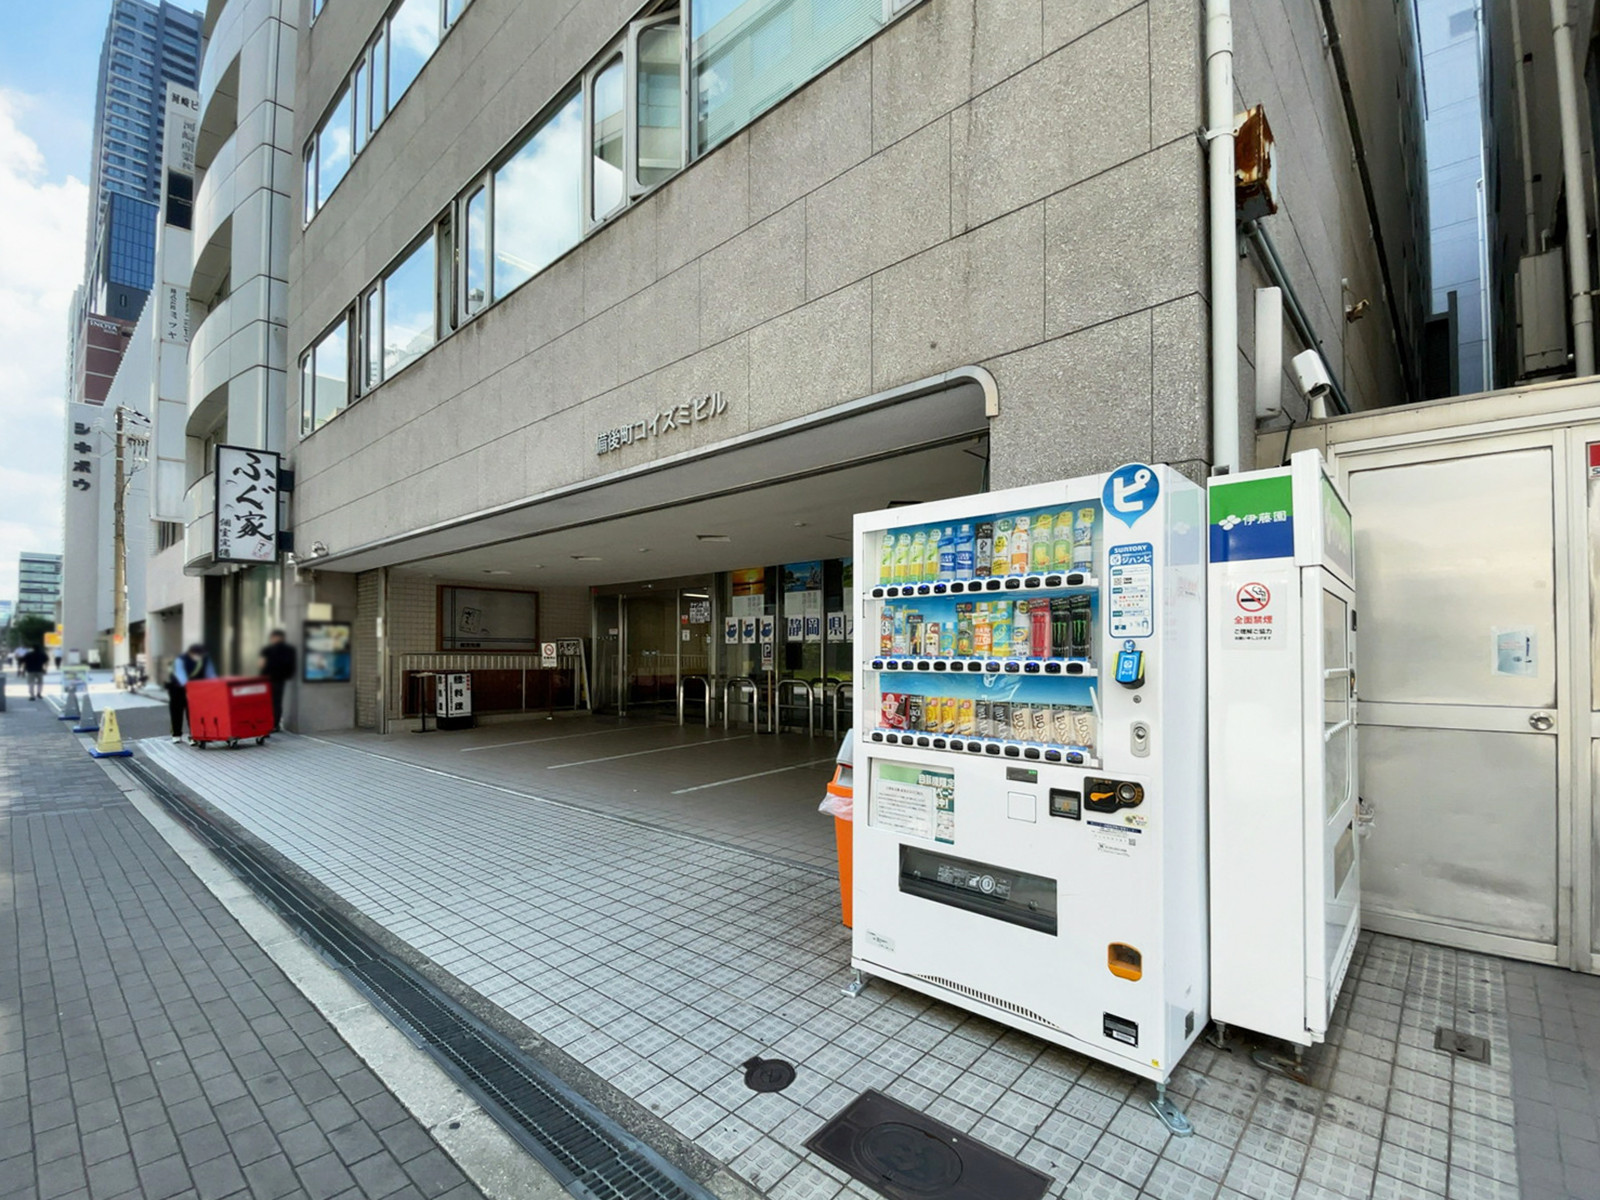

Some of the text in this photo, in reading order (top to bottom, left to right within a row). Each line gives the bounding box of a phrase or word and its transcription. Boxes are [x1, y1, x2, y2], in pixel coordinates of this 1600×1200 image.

[596, 390, 728, 455] 備後町コイズミビル
[233, 452, 276, 541] ふぐ家
[1243, 510, 1287, 526] 伊藤園
[1114, 545, 1147, 554] SUNTORY
[1234, 615, 1273, 624] 全面禁煙
[1013, 711, 1028, 741] BOSS
[1034, 713, 1048, 742] BOSS
[1055, 714, 1070, 745] BOSS
[1077, 716, 1092, 747] BOSS
